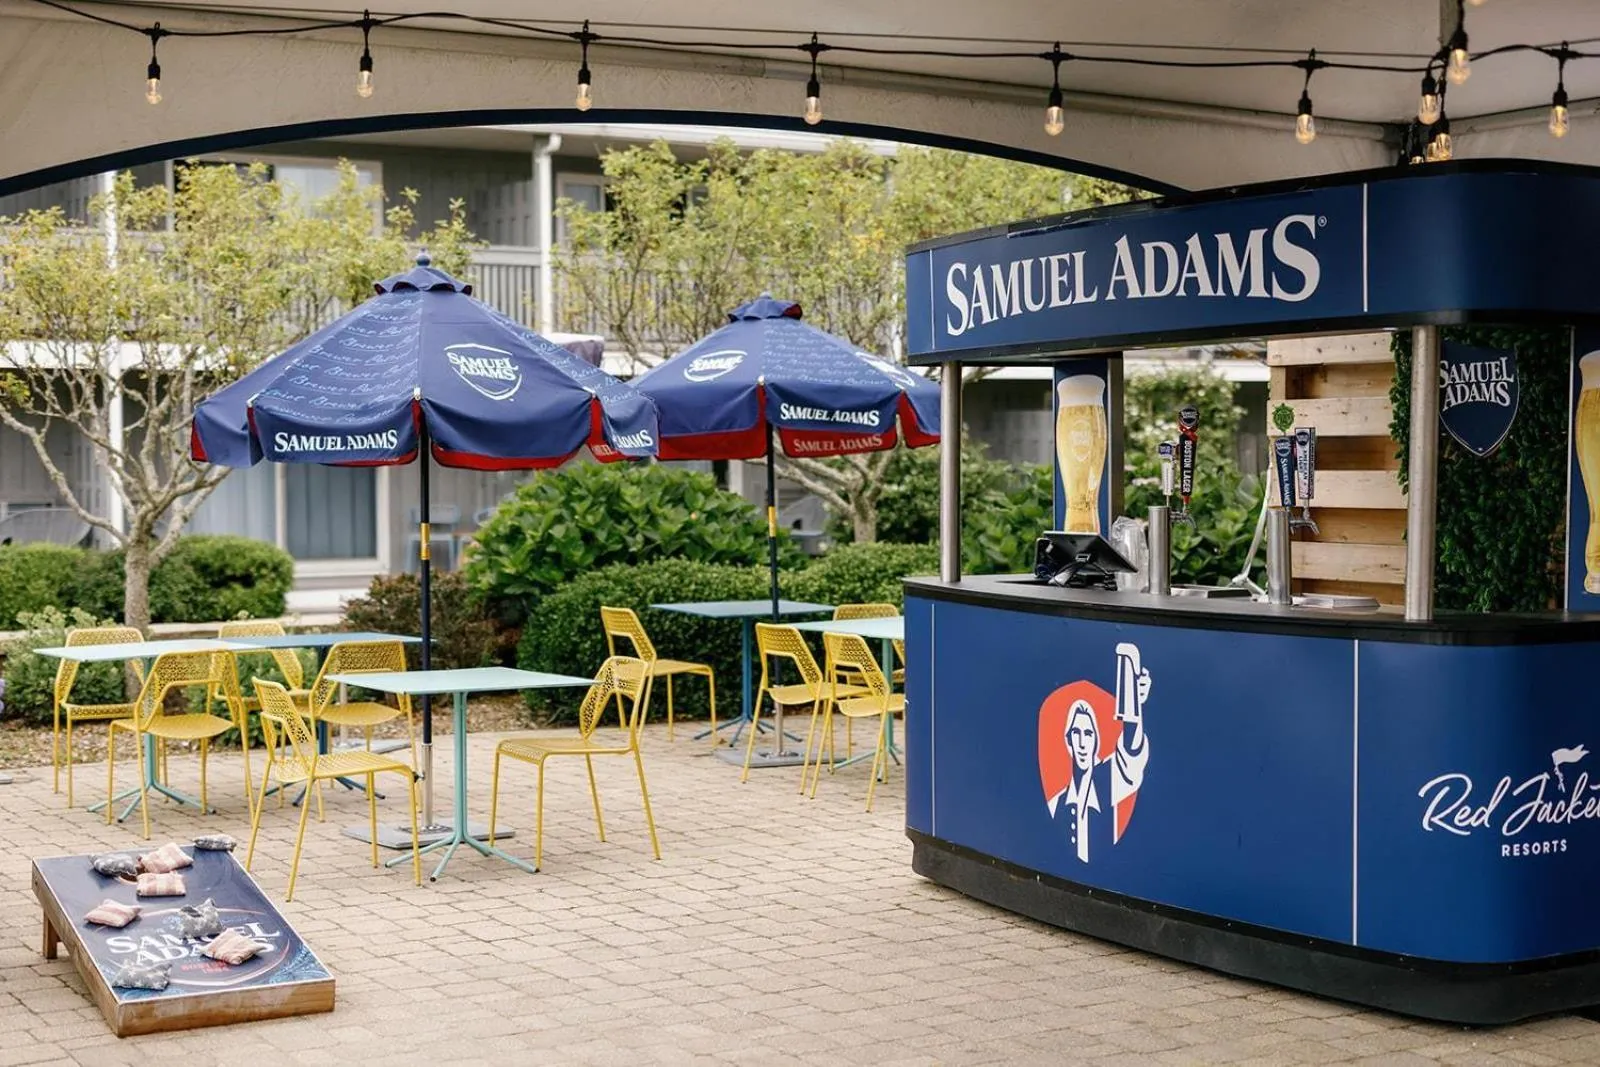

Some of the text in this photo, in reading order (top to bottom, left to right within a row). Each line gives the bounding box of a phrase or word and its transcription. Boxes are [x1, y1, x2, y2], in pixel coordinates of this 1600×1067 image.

[946, 250, 1098, 336] SAMUEL
[446, 352, 519, 371] SAMUEL
[1439, 356, 1515, 388] SAMUEL
[1442, 381, 1511, 412] ADAMS
[780, 402, 880, 426] SAMUEL ADAMS
[274, 429, 398, 453] SAMUEL ADAMS
[793, 434, 883, 452] SAMUEL ADAMS
[1182, 440, 1192, 493] BOSTON LAGER
[1418, 773, 1512, 836] Red
[1501, 839, 1567, 857] RESORTS
